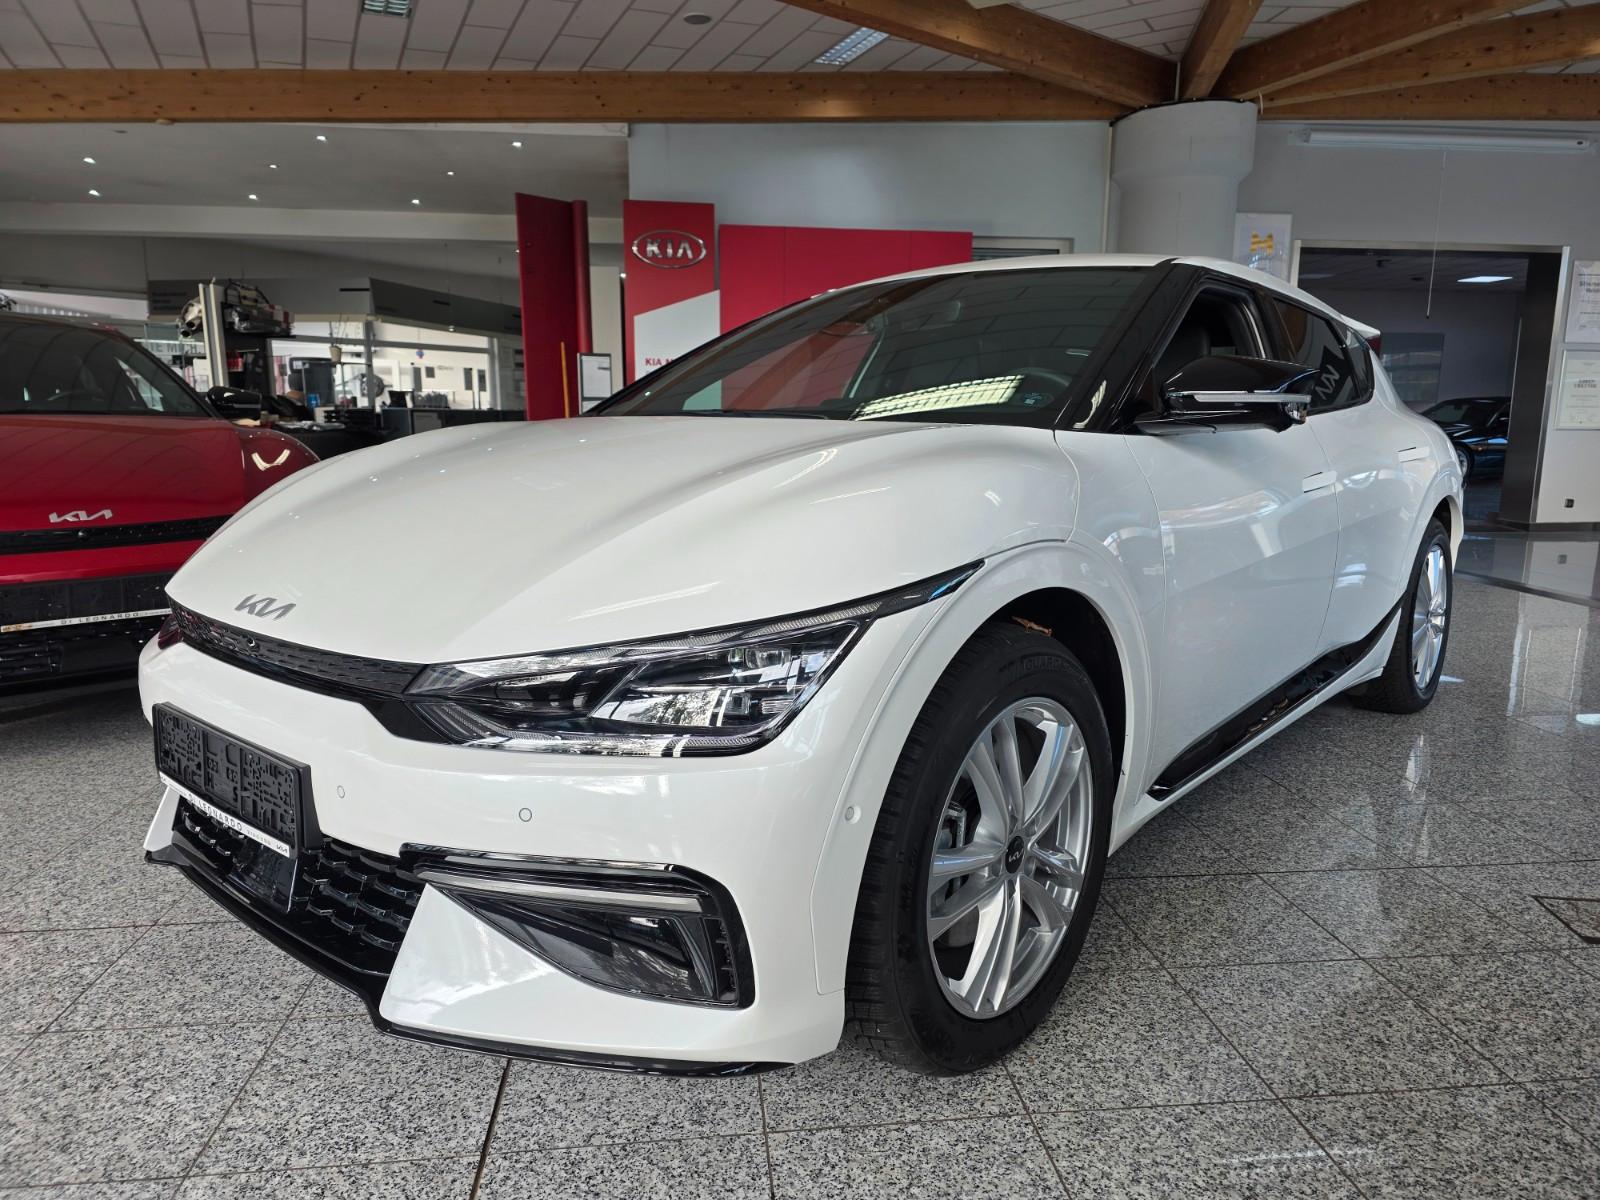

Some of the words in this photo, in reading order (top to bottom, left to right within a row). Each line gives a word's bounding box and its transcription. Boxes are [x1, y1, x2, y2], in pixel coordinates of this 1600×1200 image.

[646, 239, 693, 259] KIA
[645, 358, 662, 366] KIA
[48, 509, 113, 523] KIA
[235, 594, 296, 620] KIA
[79, 612, 139, 623] LEONARDO
[199, 801, 243, 831] LEONARDO
